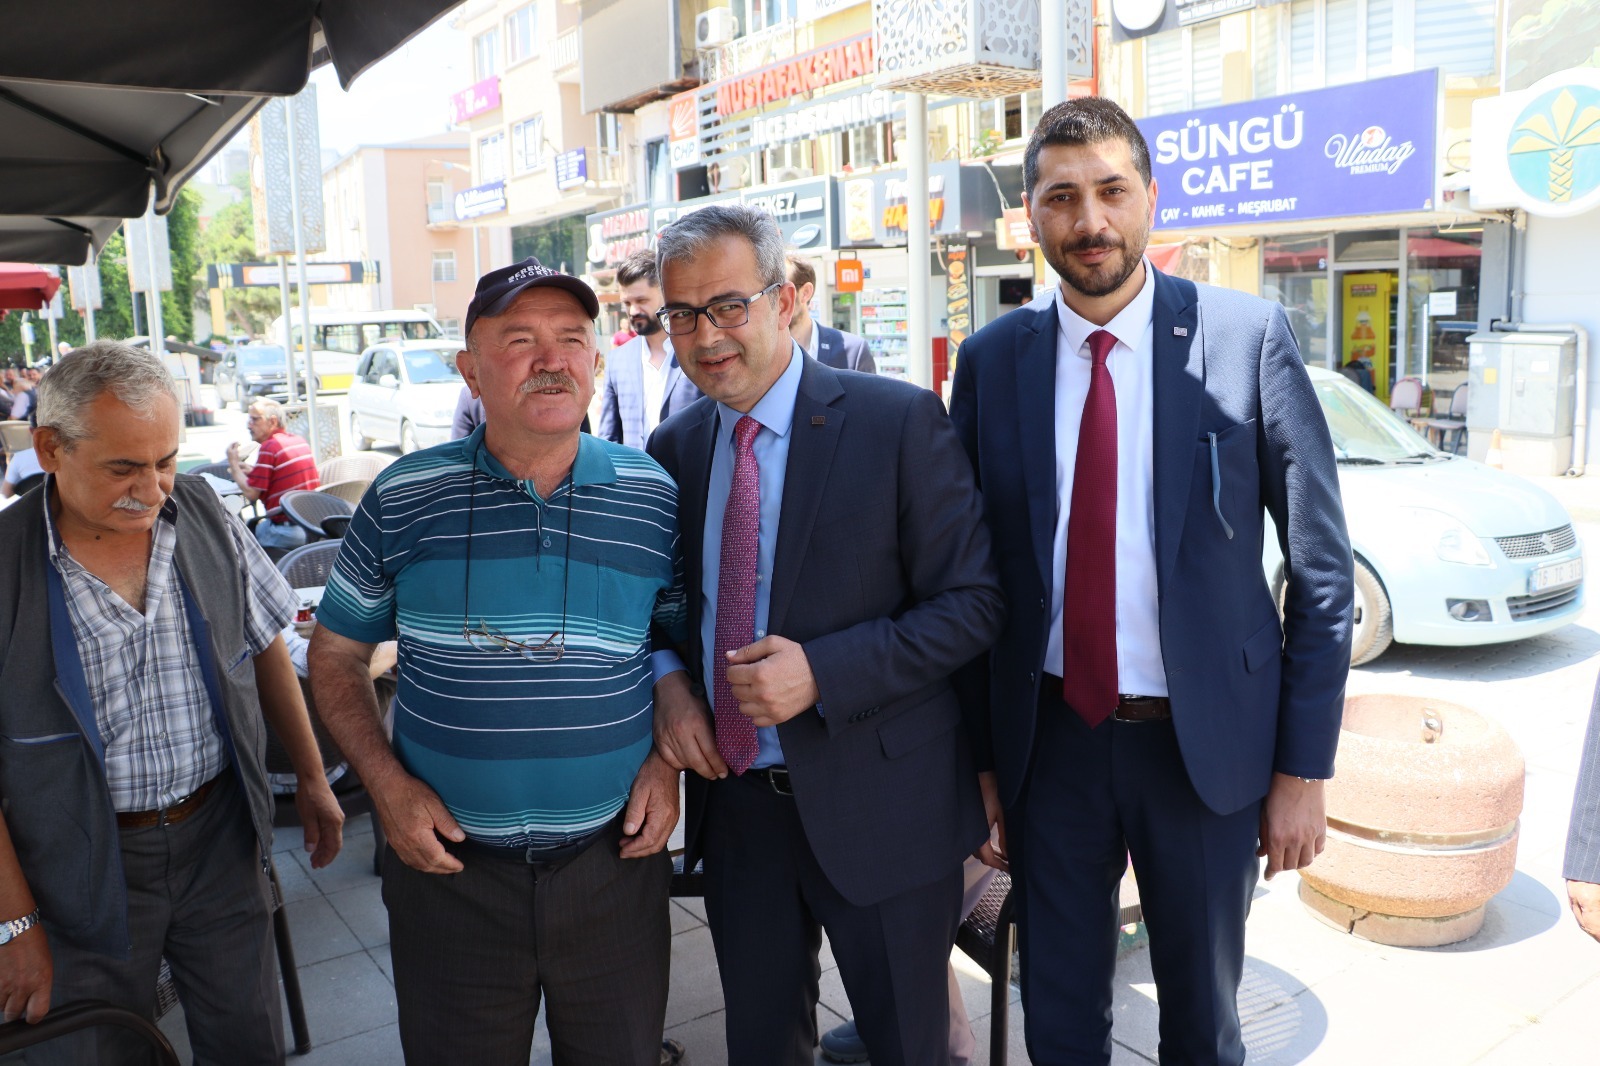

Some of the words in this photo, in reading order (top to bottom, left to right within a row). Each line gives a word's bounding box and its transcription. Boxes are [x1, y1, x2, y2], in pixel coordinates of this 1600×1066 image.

[716, 36, 874, 117] MUSTAFAKEMAL
[1155, 103, 1304, 164] SÜNGÜ
[674, 141, 695, 161] CHP
[1181, 159, 1273, 195] CAFE
[1350, 162, 1388, 175] PREMIUM
[747, 191, 795, 216] ERKEZ
[1161, 208, 1180, 223] ÇAY
[1191, 204, 1225, 218] KAHVE
[1237, 197, 1297, 216] MEŞRUBAT
